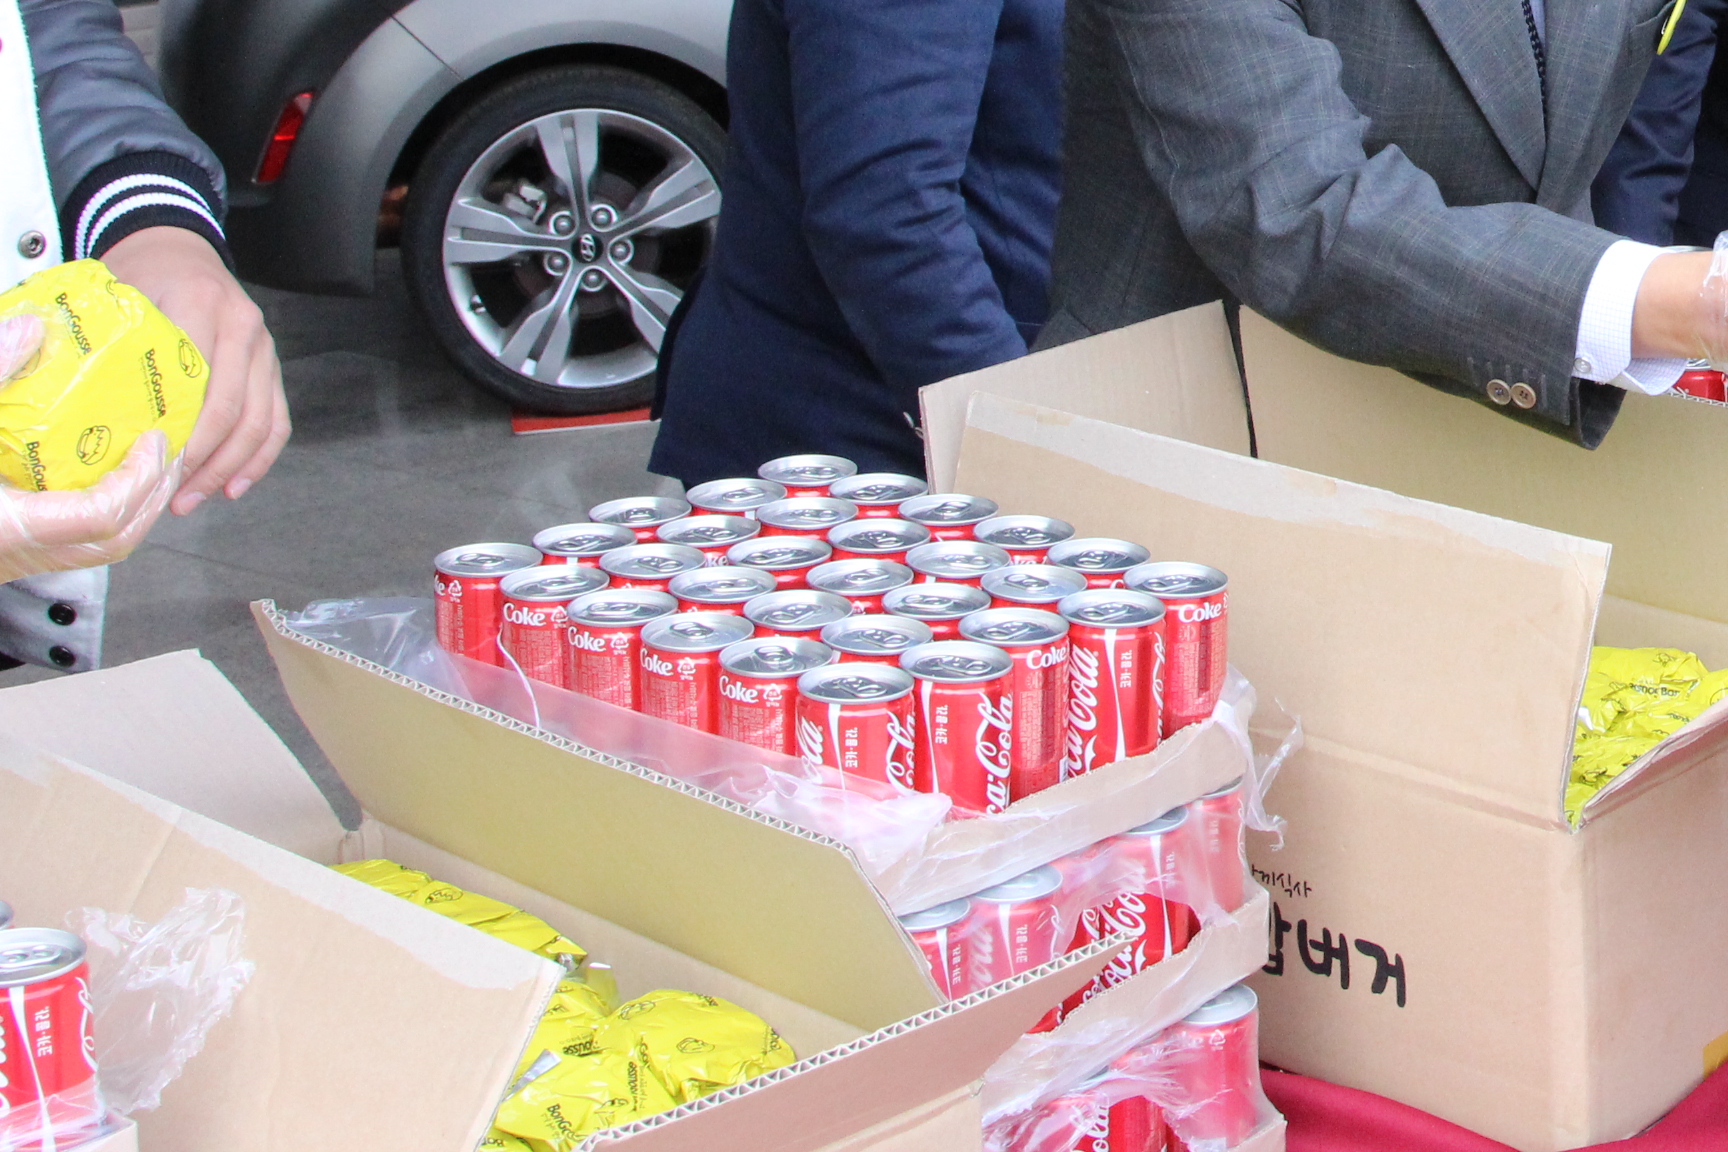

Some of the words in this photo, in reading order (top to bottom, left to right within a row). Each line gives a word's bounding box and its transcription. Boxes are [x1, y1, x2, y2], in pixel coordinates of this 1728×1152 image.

[145, 348, 167, 418] BonGousse
[26, 440, 48, 492] BonGous
[503, 602, 547, 627] Coke
[1178, 602, 1222, 624] Coke
[567, 626, 607, 653] Coke
[640, 647, 675, 677] Coke
[1025, 645, 1067, 670] Coke
[719, 675, 760, 704] Coke
